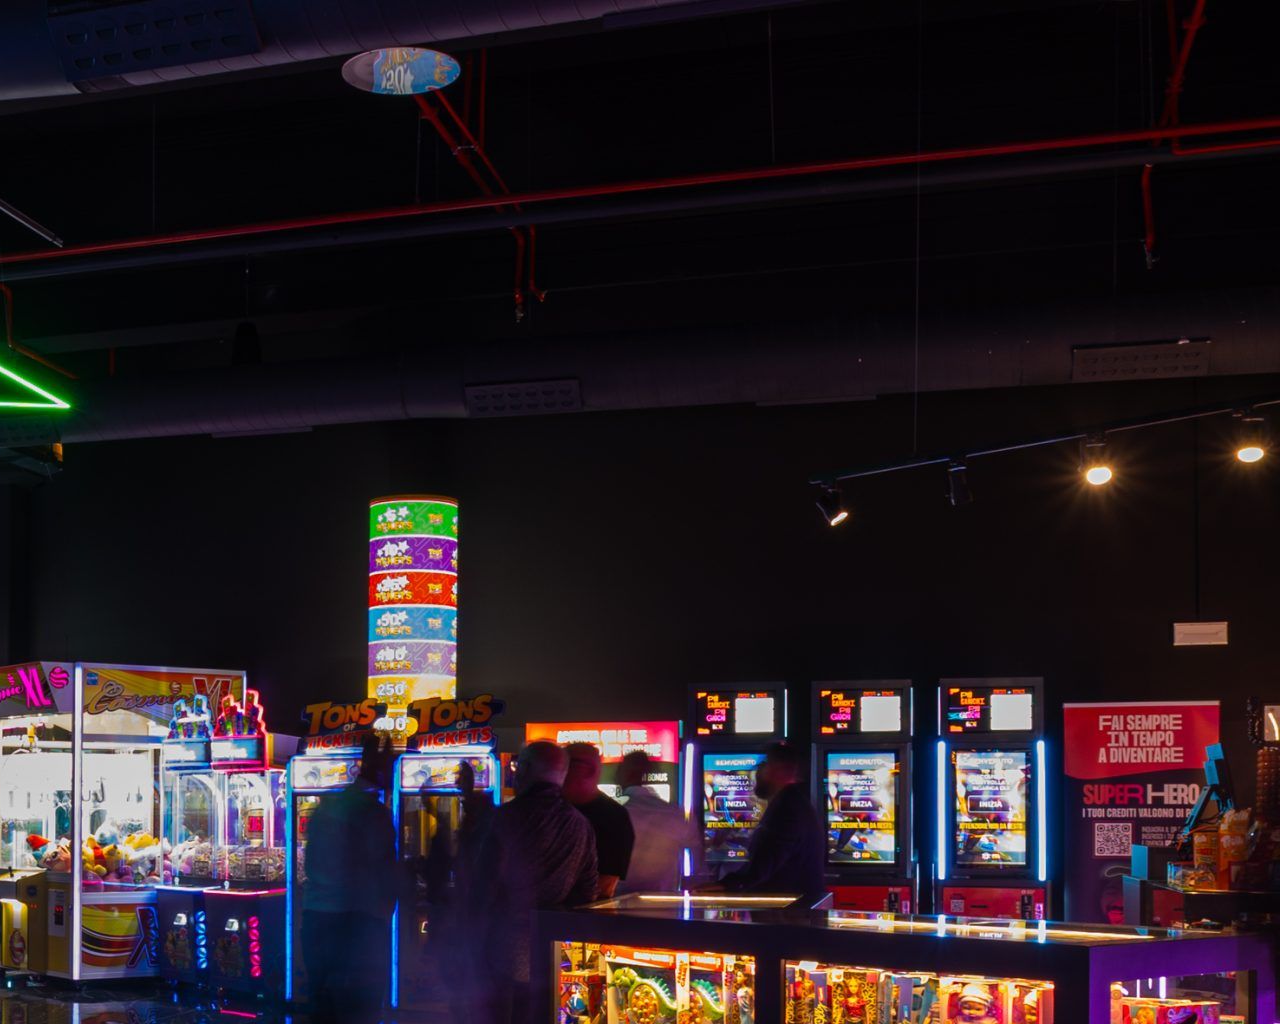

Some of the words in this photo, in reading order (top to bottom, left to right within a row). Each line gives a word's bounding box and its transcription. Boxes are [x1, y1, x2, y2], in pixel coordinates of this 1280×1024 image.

[17, 666, 52, 709] XL
[377, 683, 405, 696] 250
[306, 698, 378, 735] TONS
[412, 694, 493, 733] TONS
[343, 722, 357, 731] OF
[456, 720, 470, 730] OF
[1099, 715, 1124, 731] FAI
[1127, 714, 1183, 730] SEMPRE
[307, 731, 368, 750] TICKET
[417, 727, 493, 749] TICKETS
[1107, 731, 1128, 747] IN
[1131, 731, 1174, 747] TEMPO
[1098, 748, 1107, 763] A
[1110, 747, 1183, 763] DIVENTARE
[647, 773, 668, 782] BONUS
[1083, 784, 1144, 805] SUPER
[1146, 783, 1200, 805] HERO
[1087, 808, 1105, 818] TUOI
[1106, 808, 1137, 818] CREDITI
[1138, 807, 1174, 818] VALGONO
